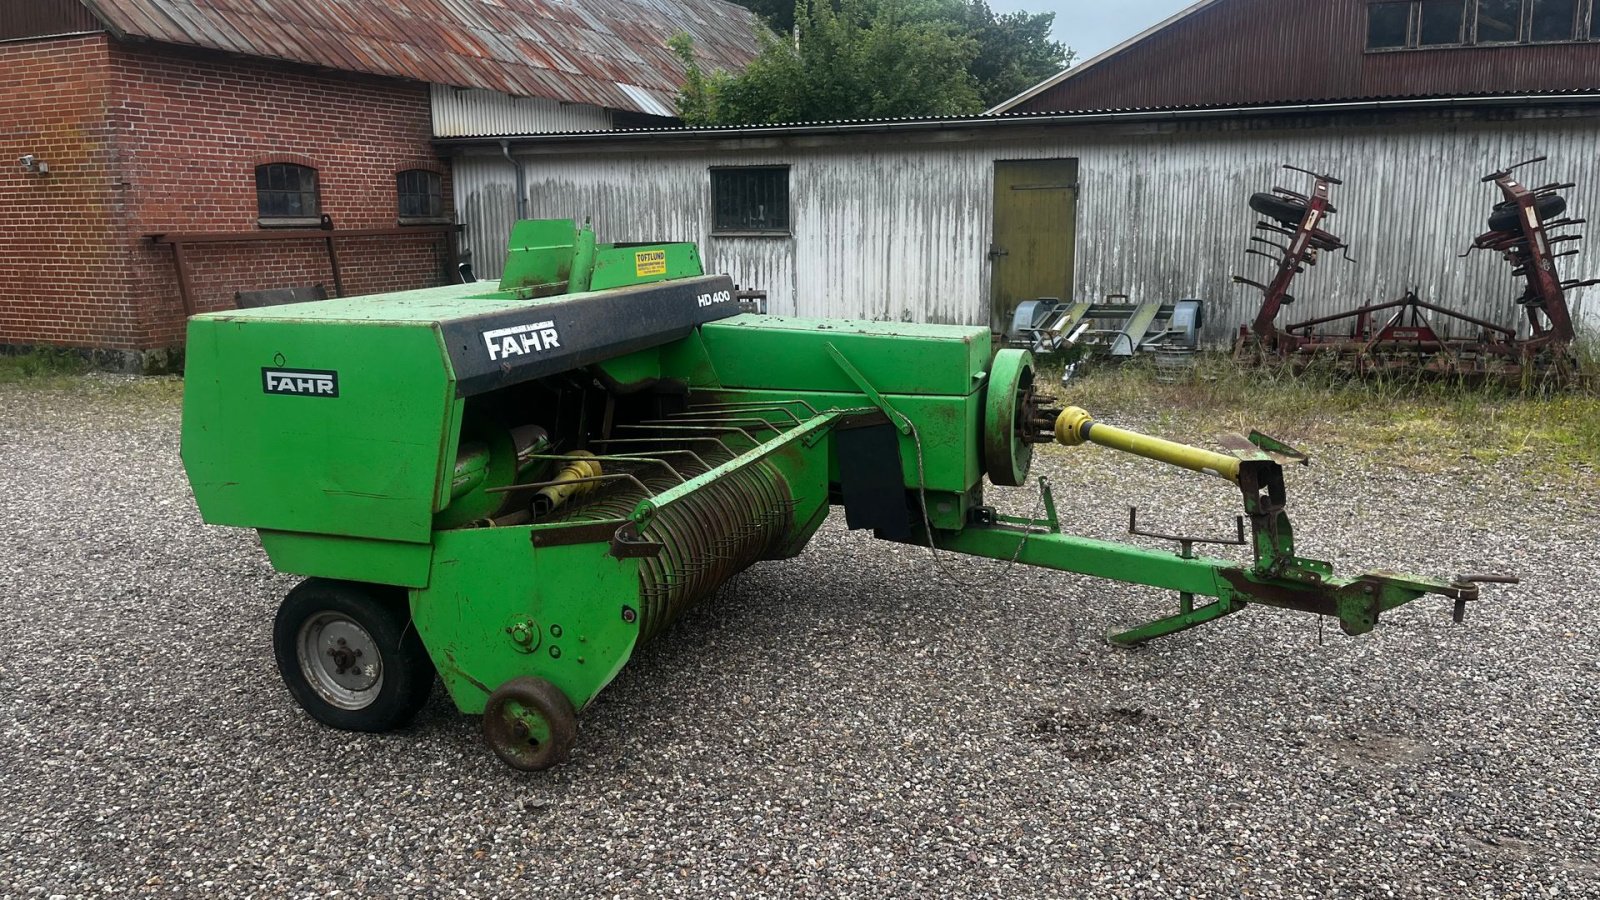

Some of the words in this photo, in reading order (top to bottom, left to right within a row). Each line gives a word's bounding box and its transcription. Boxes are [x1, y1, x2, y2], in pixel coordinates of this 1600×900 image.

[637, 252, 664, 262] TOFTLUND
[698, 294, 712, 307] HD
[713, 290, 730, 303] 400
[483, 320, 560, 361] FAHR
[266, 371, 334, 394] FAHR
